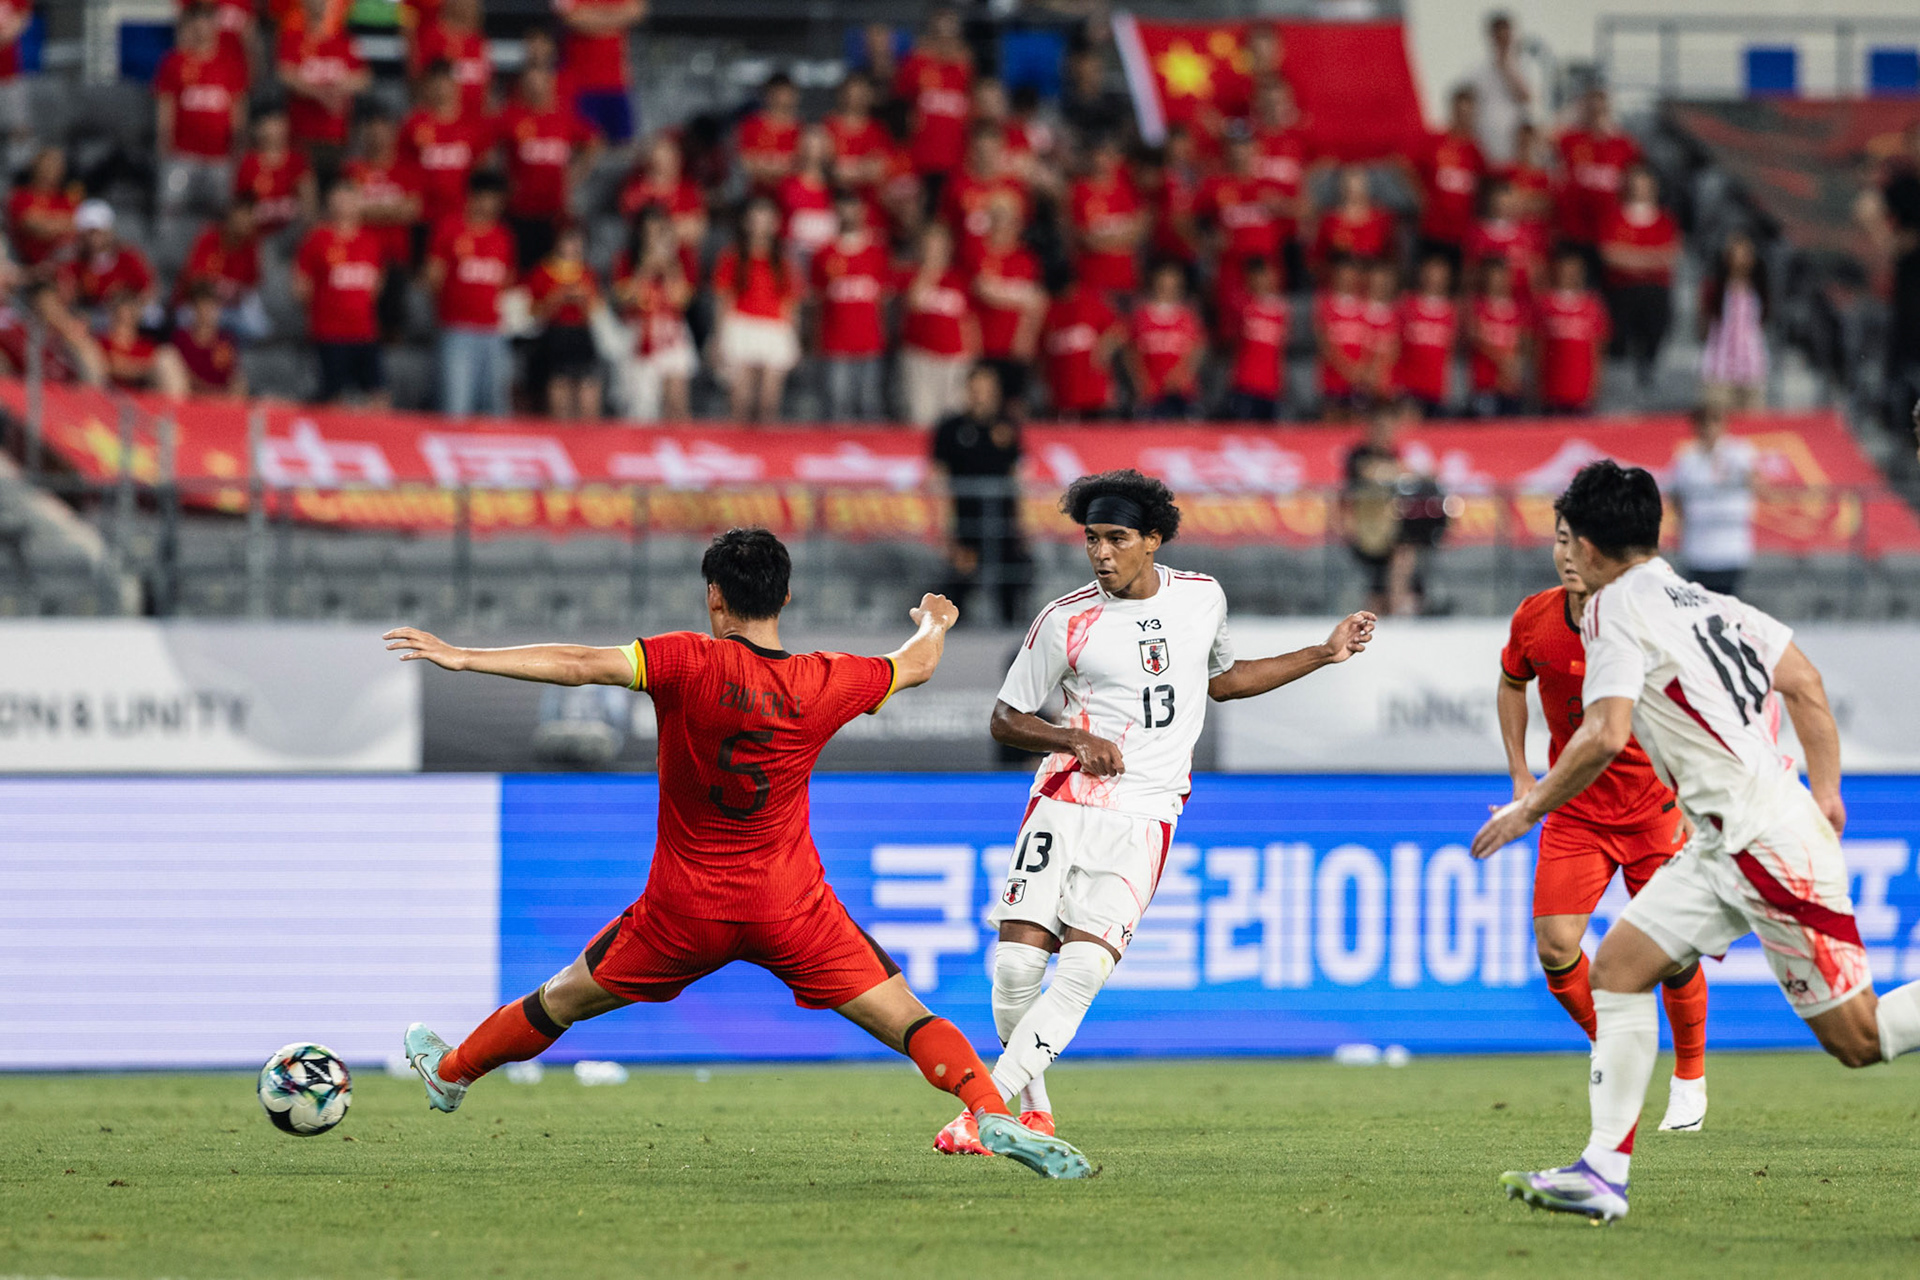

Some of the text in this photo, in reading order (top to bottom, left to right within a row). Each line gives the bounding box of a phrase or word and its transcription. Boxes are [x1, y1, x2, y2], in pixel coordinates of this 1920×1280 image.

[1136, 619, 1162, 632] Y-3
[719, 681, 757, 714] ZHU
[1142, 684, 1175, 728] 13
[709, 731, 774, 820] 5
[1015, 831, 1053, 873] 13
